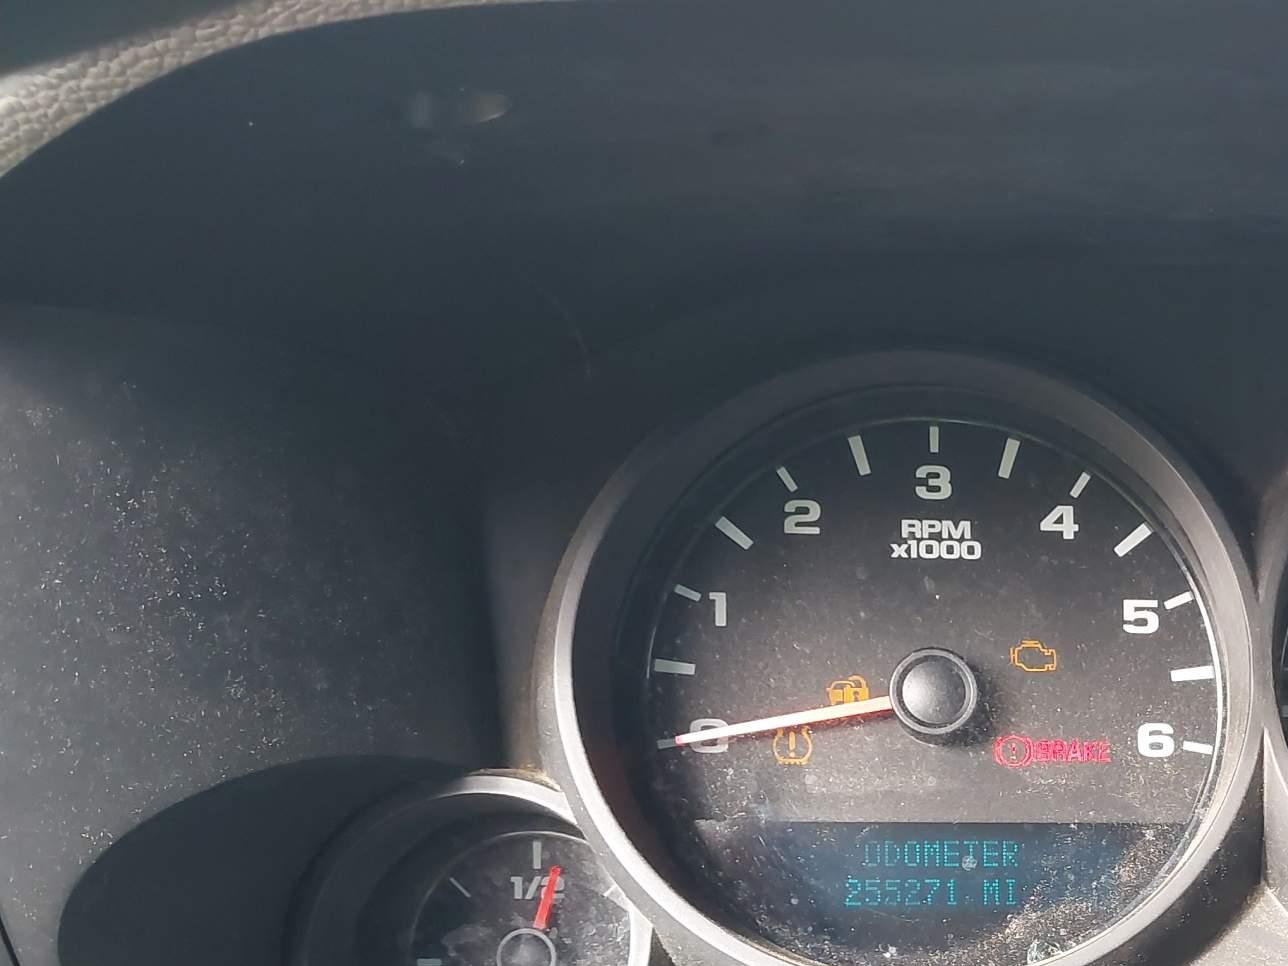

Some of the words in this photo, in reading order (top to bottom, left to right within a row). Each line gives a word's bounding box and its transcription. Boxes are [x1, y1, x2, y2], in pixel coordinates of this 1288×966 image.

[914, 465, 952, 500] 3
[783, 499, 821, 535] 2
[900, 519, 972, 541] RPM
[1039, 505, 1079, 540] 4
[890, 539, 982, 561] x1000
[708, 591, 728, 627] 1
[1122, 599, 1160, 634] 5
[689, 717, 729, 753] 0
[1032, 739, 1112, 764] BRAKE
[1136, 722, 1175, 758] 6
[863, 840, 1019, 868] ODOMETER
[844, 879, 957, 906] 255271
[983, 879, 1017, 906] MI
